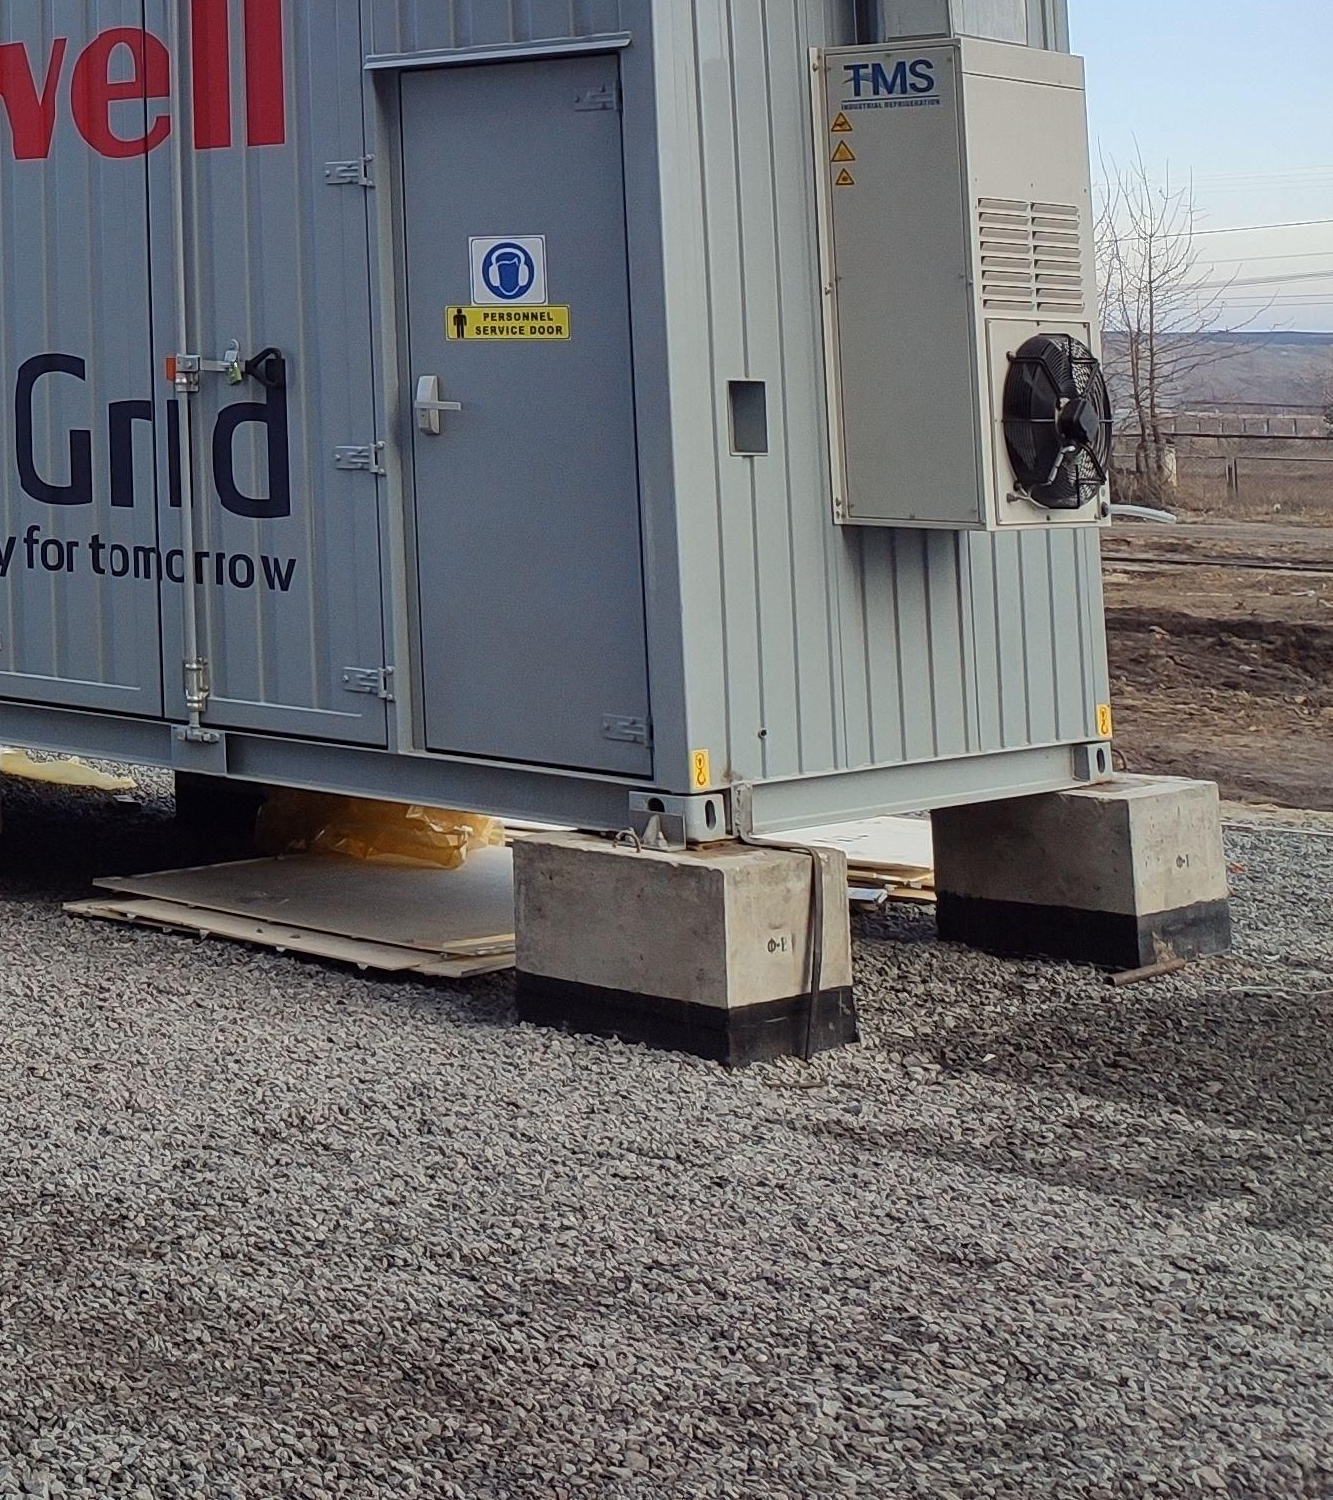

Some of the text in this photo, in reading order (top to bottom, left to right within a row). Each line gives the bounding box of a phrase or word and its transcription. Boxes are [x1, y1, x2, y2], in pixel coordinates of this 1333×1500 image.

[842, 59, 935, 97] TMS
[483, 311, 554, 322] PERSONNEL
[475, 325, 563, 336] SERVICE DOOR
[23, 525, 80, 573] for
[88, 533, 297, 592] tomorrow
